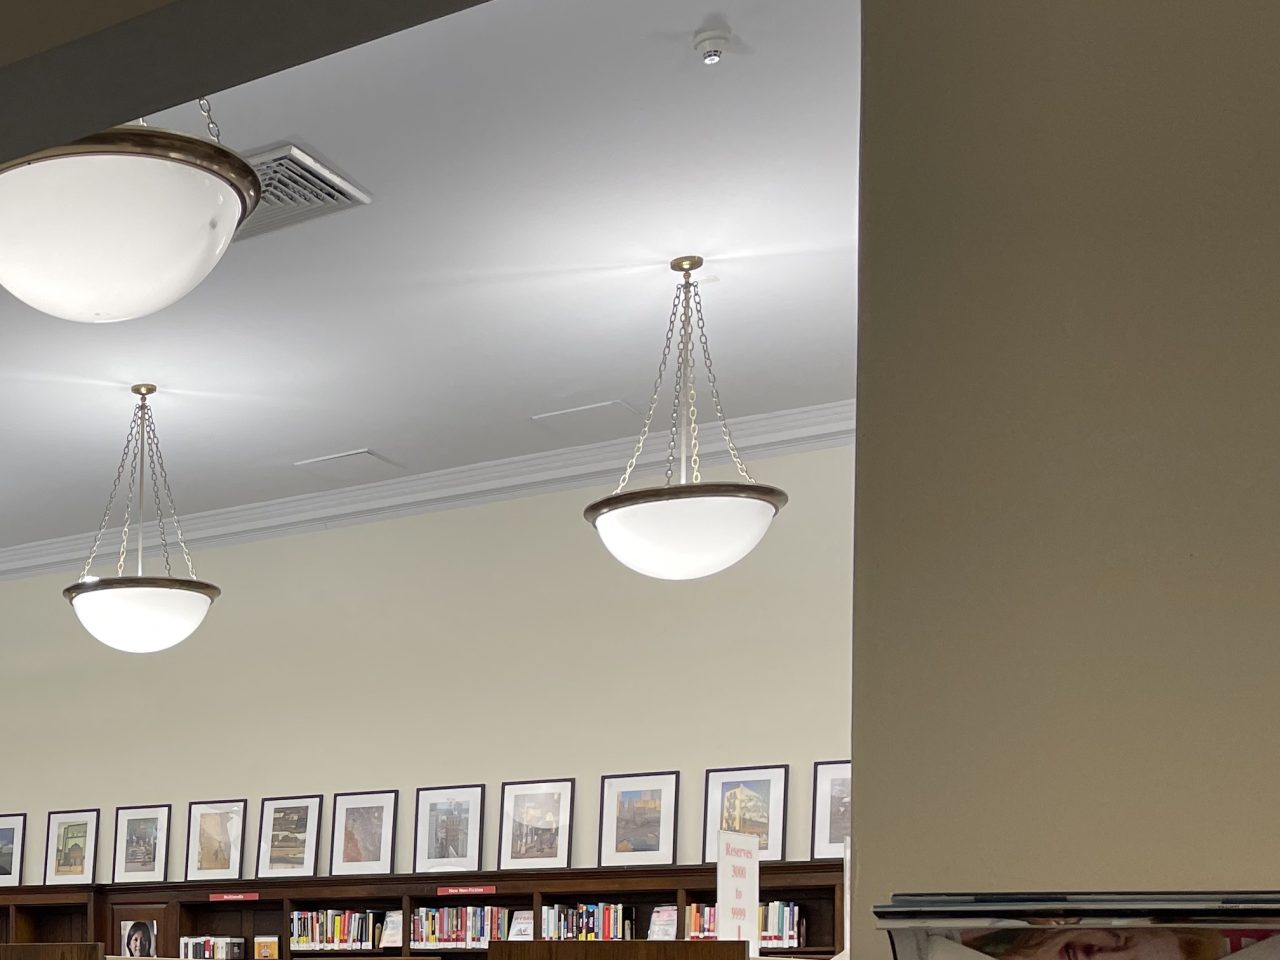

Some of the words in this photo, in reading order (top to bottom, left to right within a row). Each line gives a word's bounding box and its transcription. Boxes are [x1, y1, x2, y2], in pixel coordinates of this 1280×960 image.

[725, 842, 752, 859] Reserves
[732, 864, 746, 879] 3000
[735, 888, 742, 899] to
[731, 907, 746, 920] 9999
